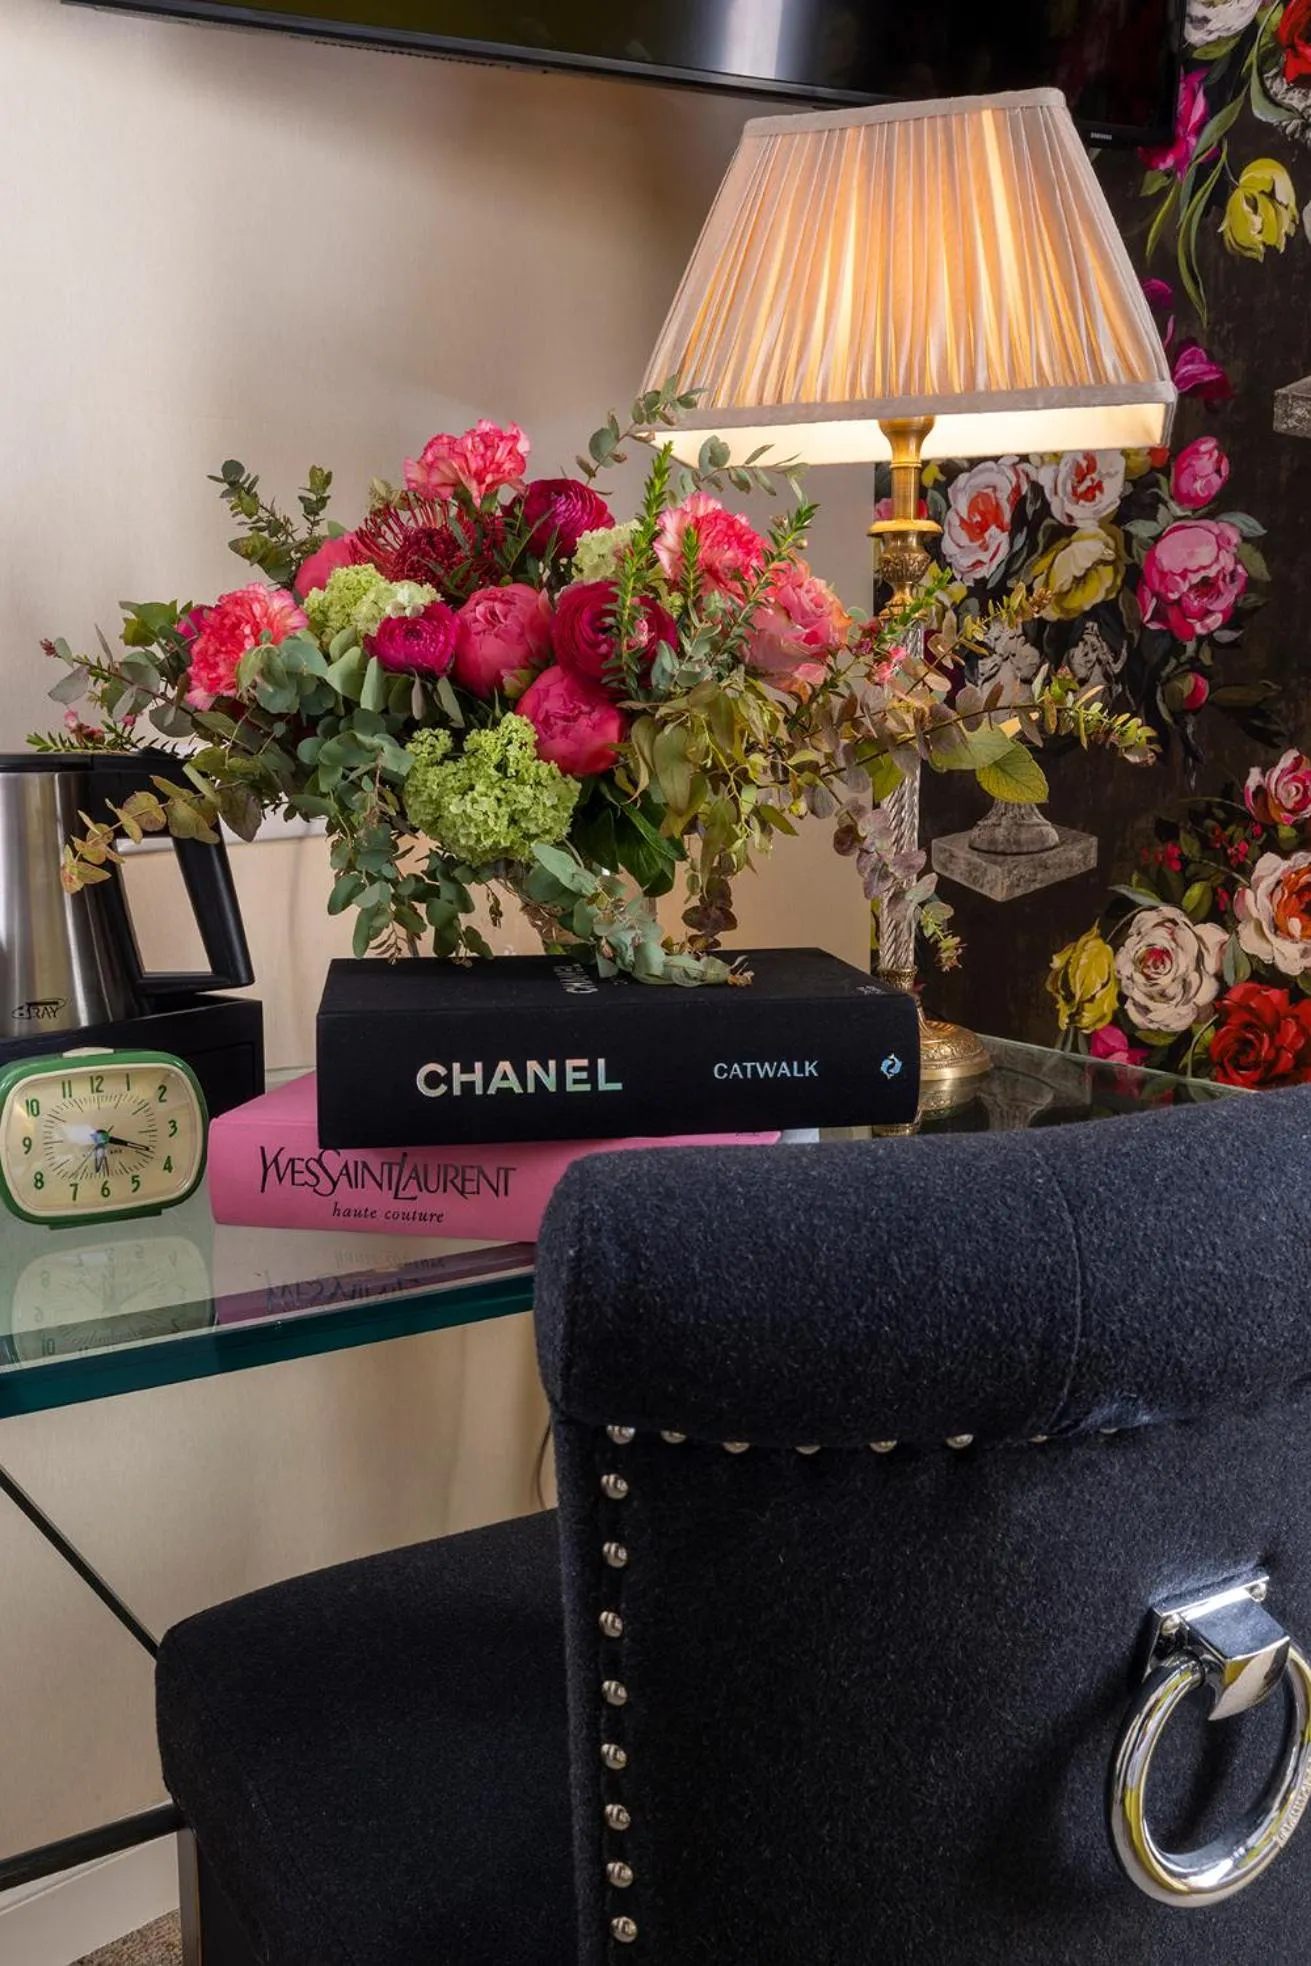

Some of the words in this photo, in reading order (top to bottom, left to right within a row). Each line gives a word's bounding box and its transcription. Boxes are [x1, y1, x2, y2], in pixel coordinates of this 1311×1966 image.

[416, 1058, 623, 1098] CHANEL
[713, 1060, 819, 1079] CATWALK
[61, 1080, 73, 1098] 11
[90, 1075, 104, 1093] 12
[125, 1073, 131, 1091] 1
[158, 1085, 167, 1103] 2
[25, 1098, 40, 1118] 10
[168, 1120, 178, 1137] 3
[22, 1136, 32, 1154] 9
[163, 1156, 173, 1173] 4
[34, 1172, 44, 1190] 8
[101, 1180, 110, 1198] 6
[131, 1175, 140, 1193] 5
[69, 1183, 79, 1201] 7
[332, 1202, 378, 1220] haute
[384, 1206, 445, 1224] couture
